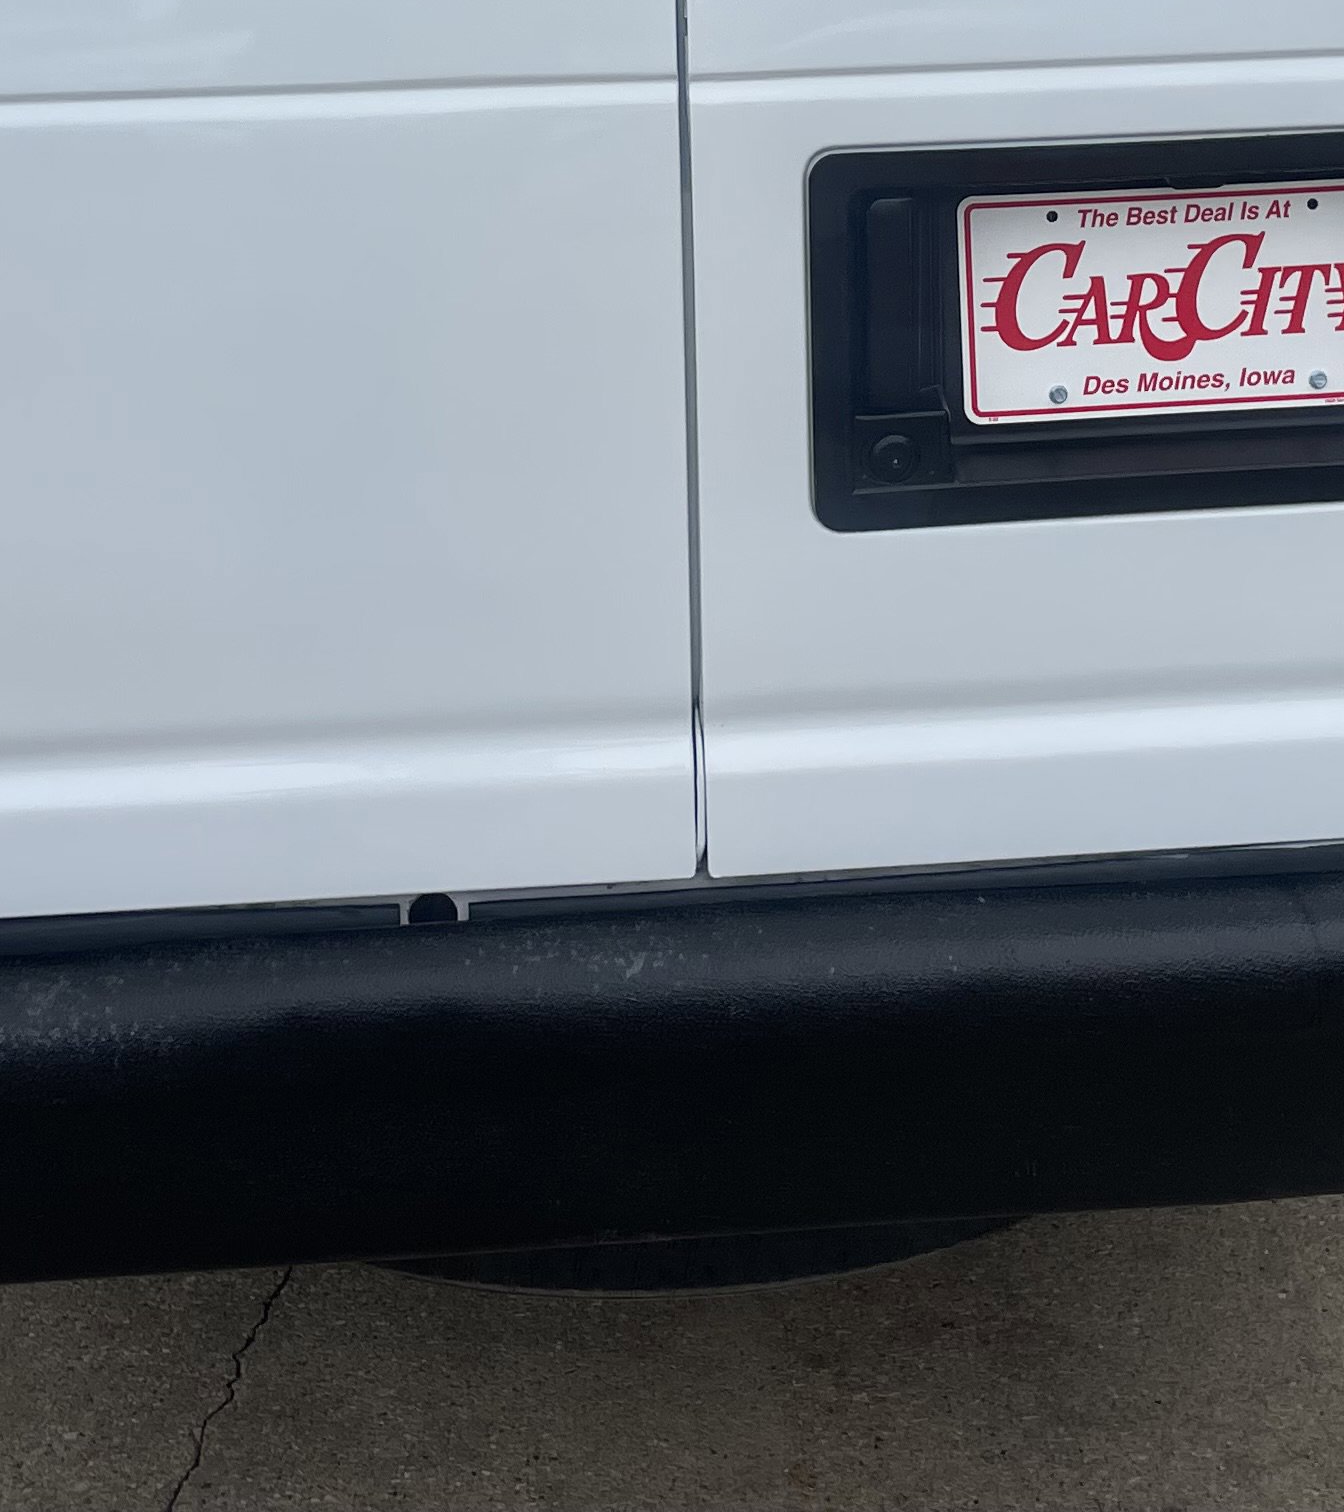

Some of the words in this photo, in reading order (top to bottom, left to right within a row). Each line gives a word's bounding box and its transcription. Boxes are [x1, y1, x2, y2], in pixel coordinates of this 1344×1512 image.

[1078, 208, 1119, 228] The
[1126, 204, 1177, 226] Best
[1184, 201, 1233, 223] Deal
[1241, 201, 1260, 220] Is
[1265, 198, 1292, 219] At
[1083, 375, 1130, 396] Des
[1137, 371, 1231, 394] Moines,
[1240, 367, 1296, 387] Iowa
